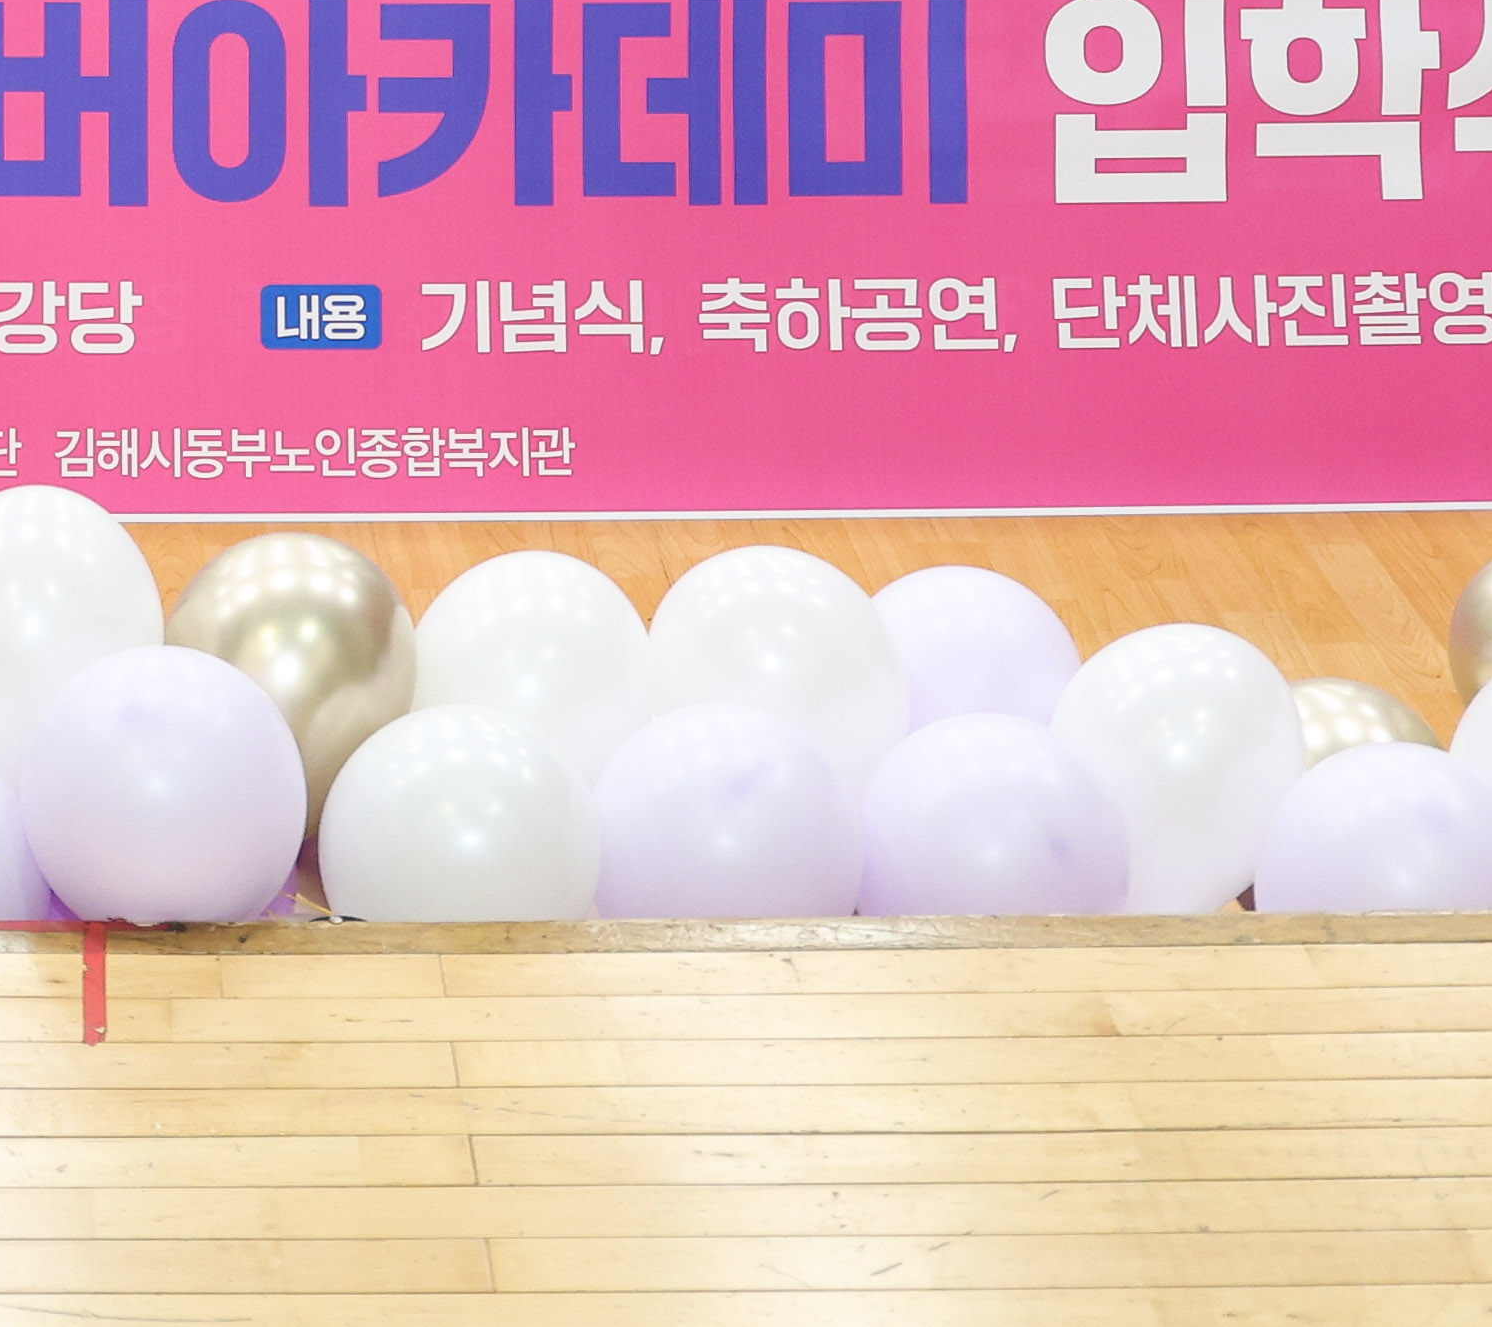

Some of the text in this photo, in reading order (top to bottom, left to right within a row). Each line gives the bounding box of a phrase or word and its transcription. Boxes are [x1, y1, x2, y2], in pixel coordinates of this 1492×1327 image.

[275, 293, 369, 341] 내용
[419, 277, 665, 355] 기념식,
[698, 275, 1019, 354] 축하공연,
[53, 423, 577, 481] 김해시동부노인종합복지관
